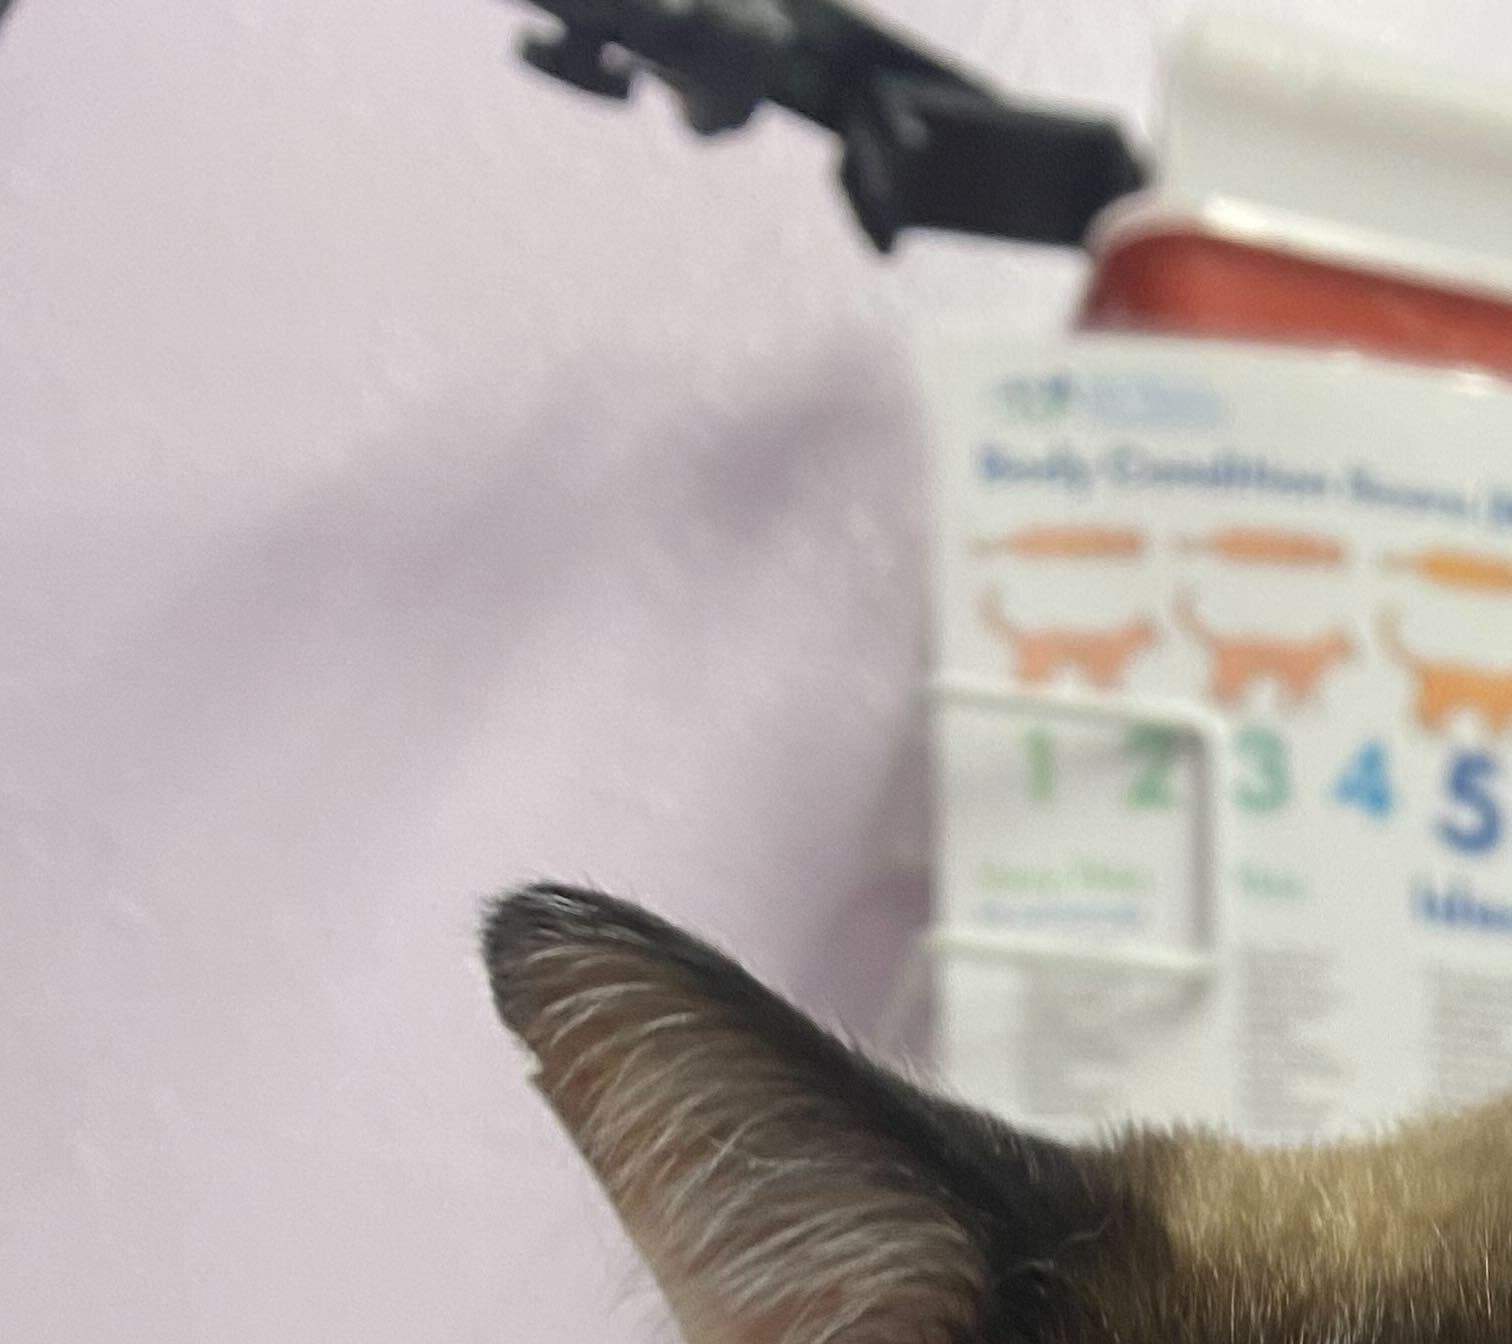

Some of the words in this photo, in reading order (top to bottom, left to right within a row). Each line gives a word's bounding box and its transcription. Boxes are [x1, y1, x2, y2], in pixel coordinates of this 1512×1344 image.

[1122, 718, 1182, 812] 2
[1232, 720, 1292, 818] 3
[1328, 738, 1396, 822] 4
[1432, 746, 1504, 855] 5
